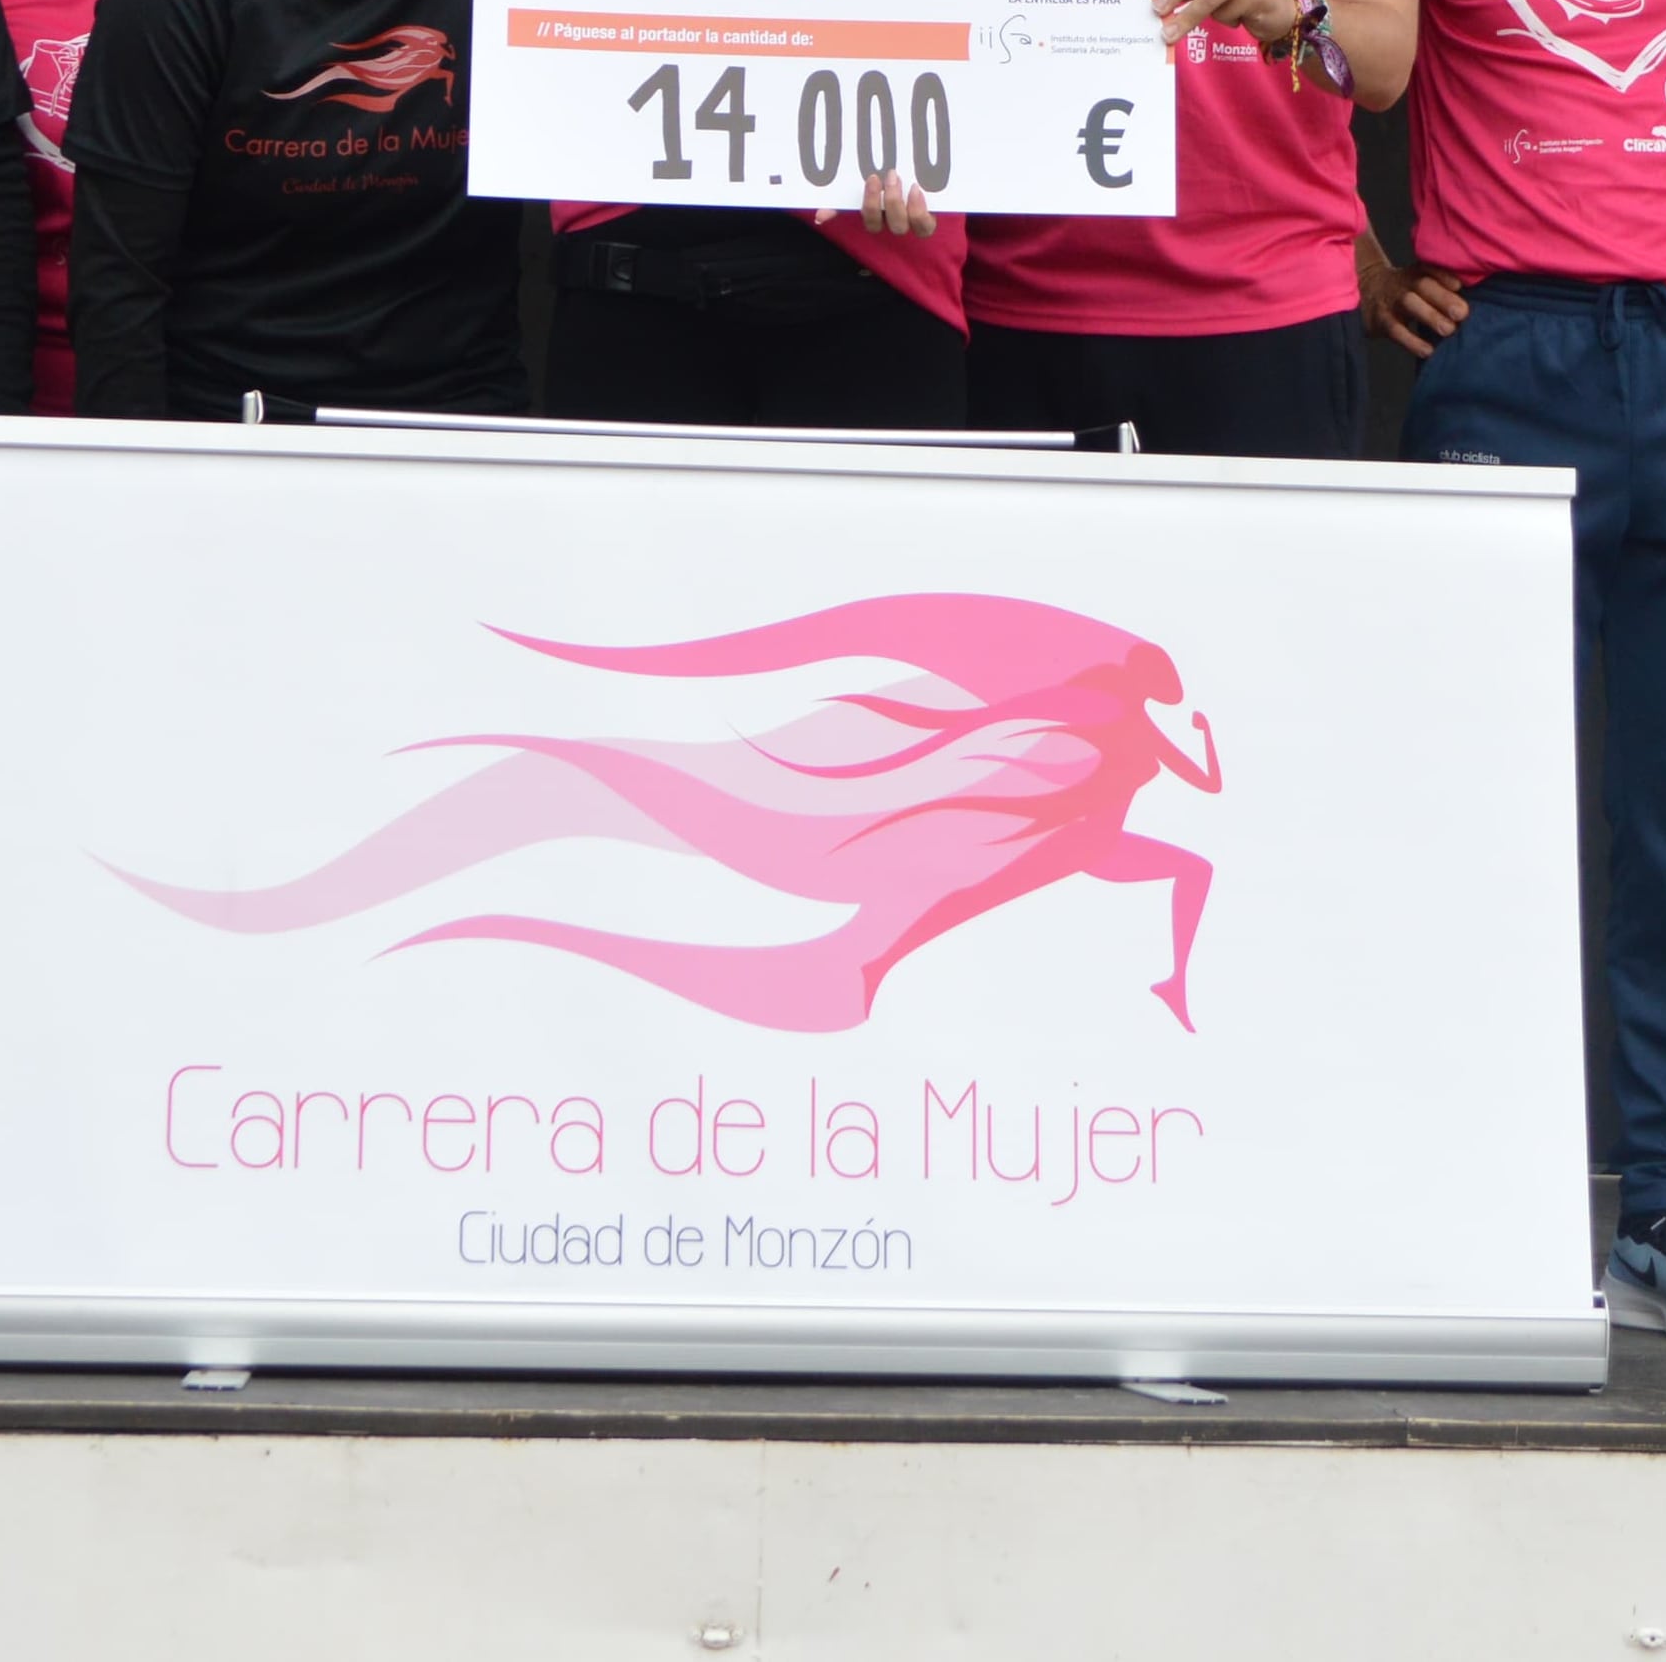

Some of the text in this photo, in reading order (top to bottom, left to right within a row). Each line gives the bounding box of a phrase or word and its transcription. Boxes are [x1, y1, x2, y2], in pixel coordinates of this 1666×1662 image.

[554, 22, 616, 42] Páguese
[620, 25, 634, 40] al
[639, 26, 701, 44] portador
[706, 29, 719, 44] la
[723, 29, 787, 45] cantidad
[791, 31, 814, 46] de:
[1051, 34, 1084, 43] Instituto
[1087, 35, 1097, 44] de
[1089, 46, 1121, 56] Aragón
[1213, 42, 1258, 55] Monzón
[224, 125, 470, 158] Carrera de la Muje
[627, 63, 1135, 193] 14.000 €
[166, 1064, 1205, 1206] Carrera de la Mujer
[458, 1210, 913, 1270] Ciudad de Monzón
